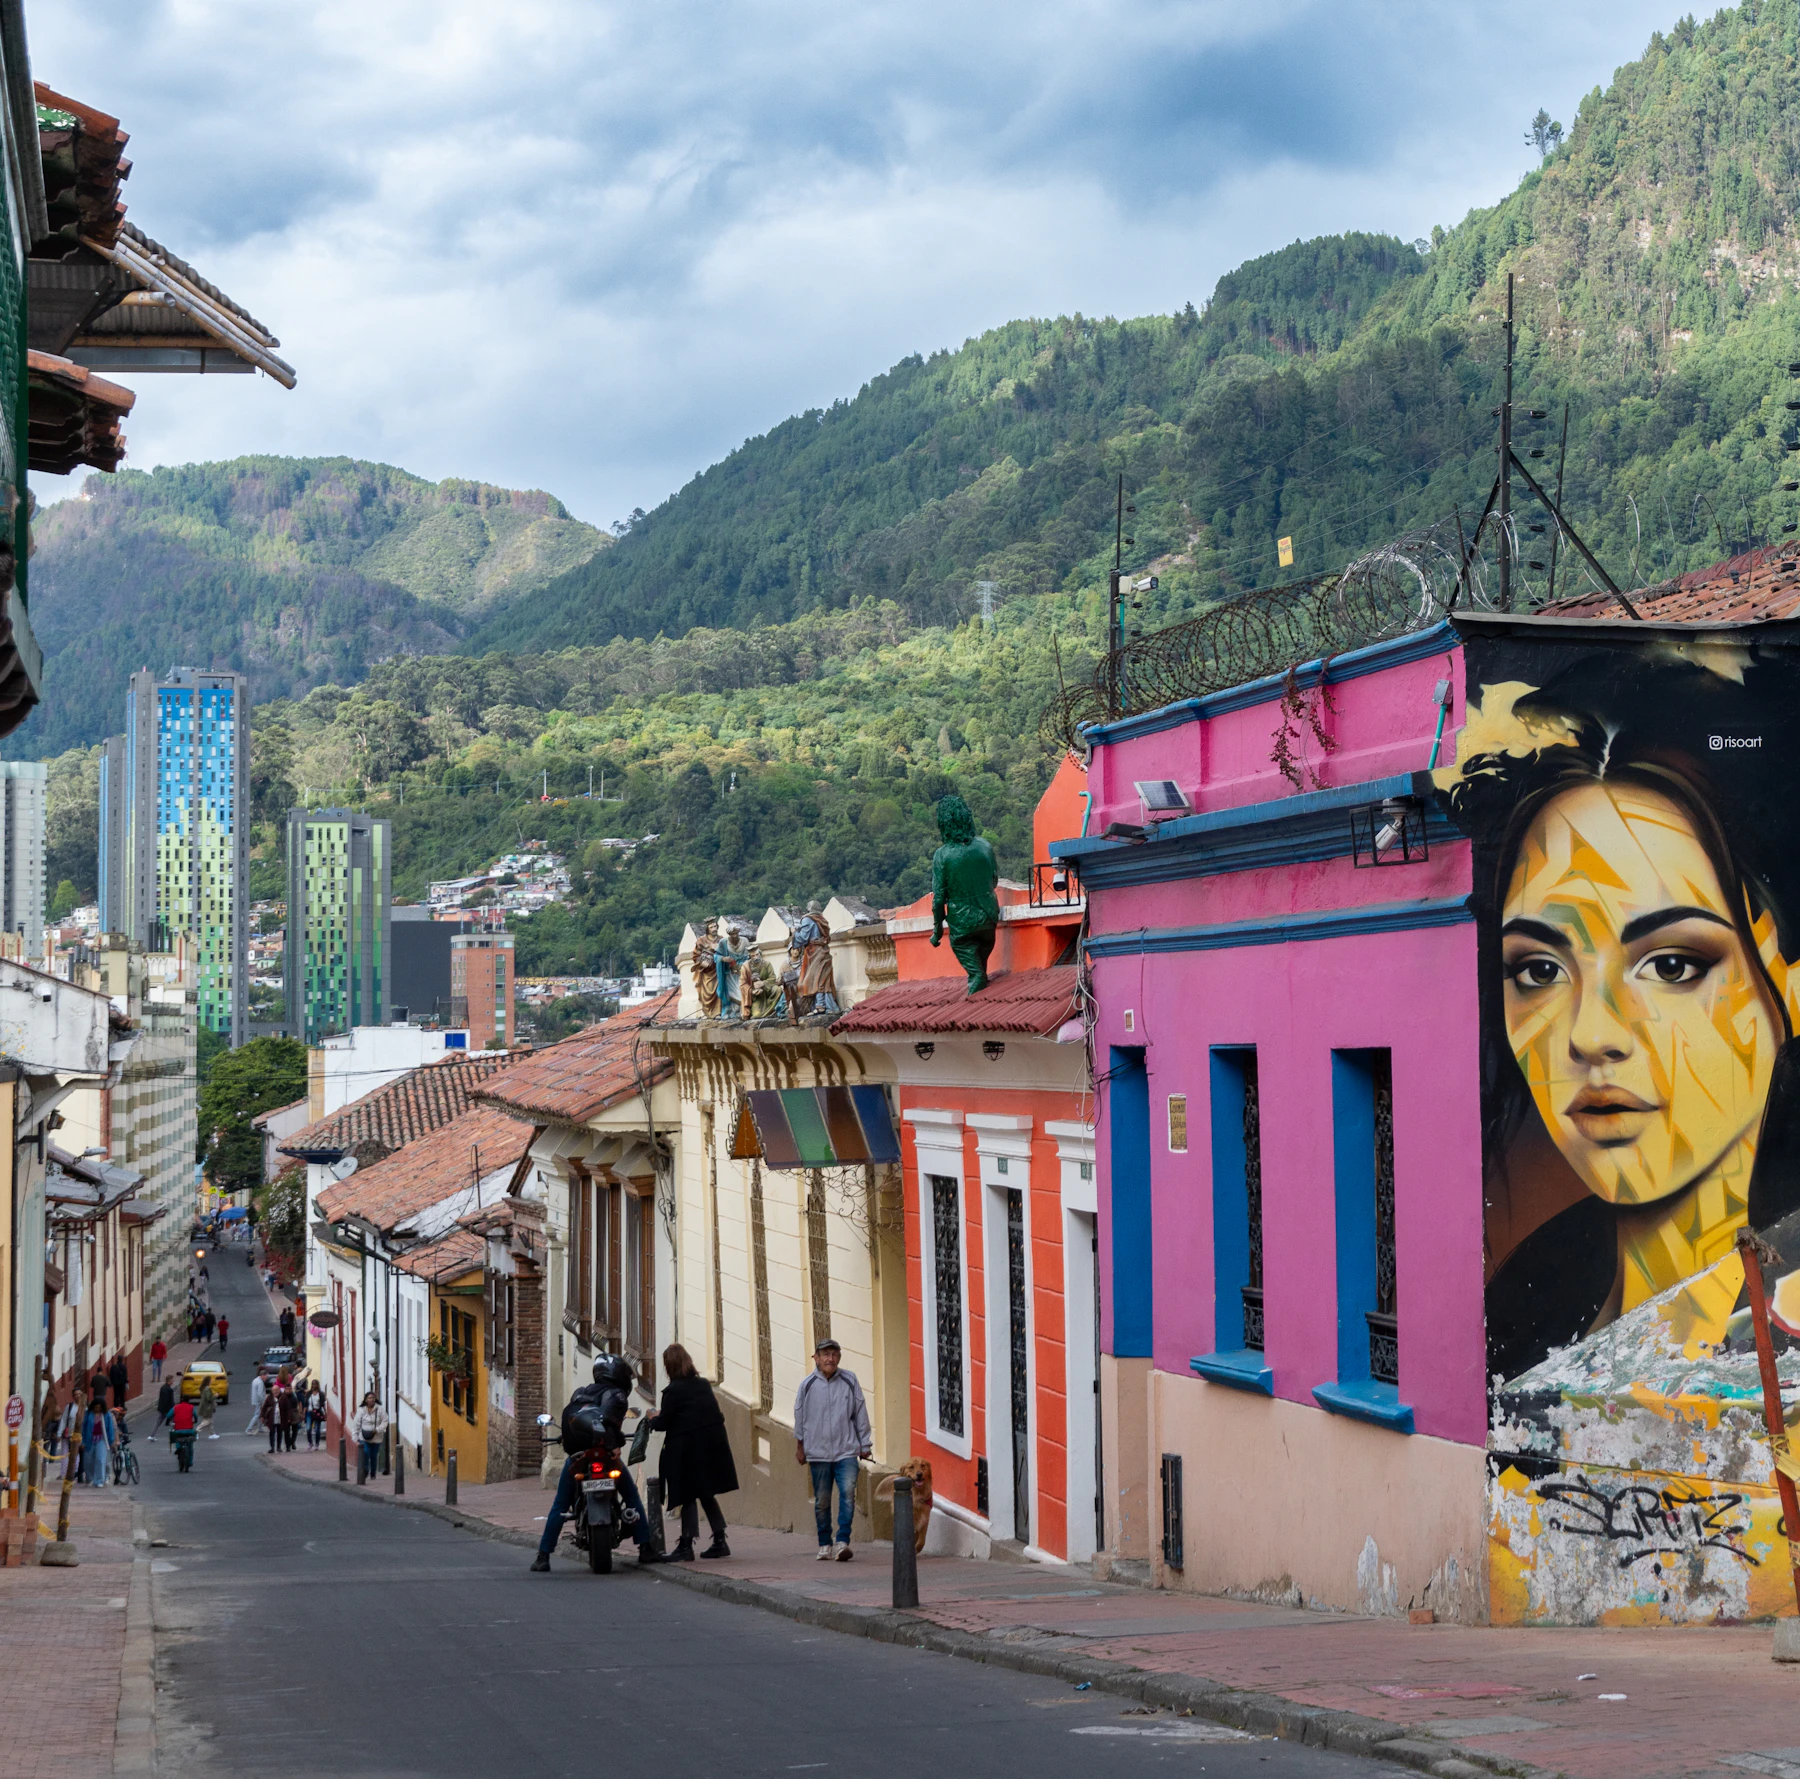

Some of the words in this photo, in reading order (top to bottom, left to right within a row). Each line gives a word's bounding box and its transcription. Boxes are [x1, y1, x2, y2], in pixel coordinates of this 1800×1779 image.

[1724, 735, 1763, 748] risoart
[11, 1398, 21, 1407] NO
[9, 1406, 22, 1415] HAY
[8, 1414, 22, 1424] CUPO
